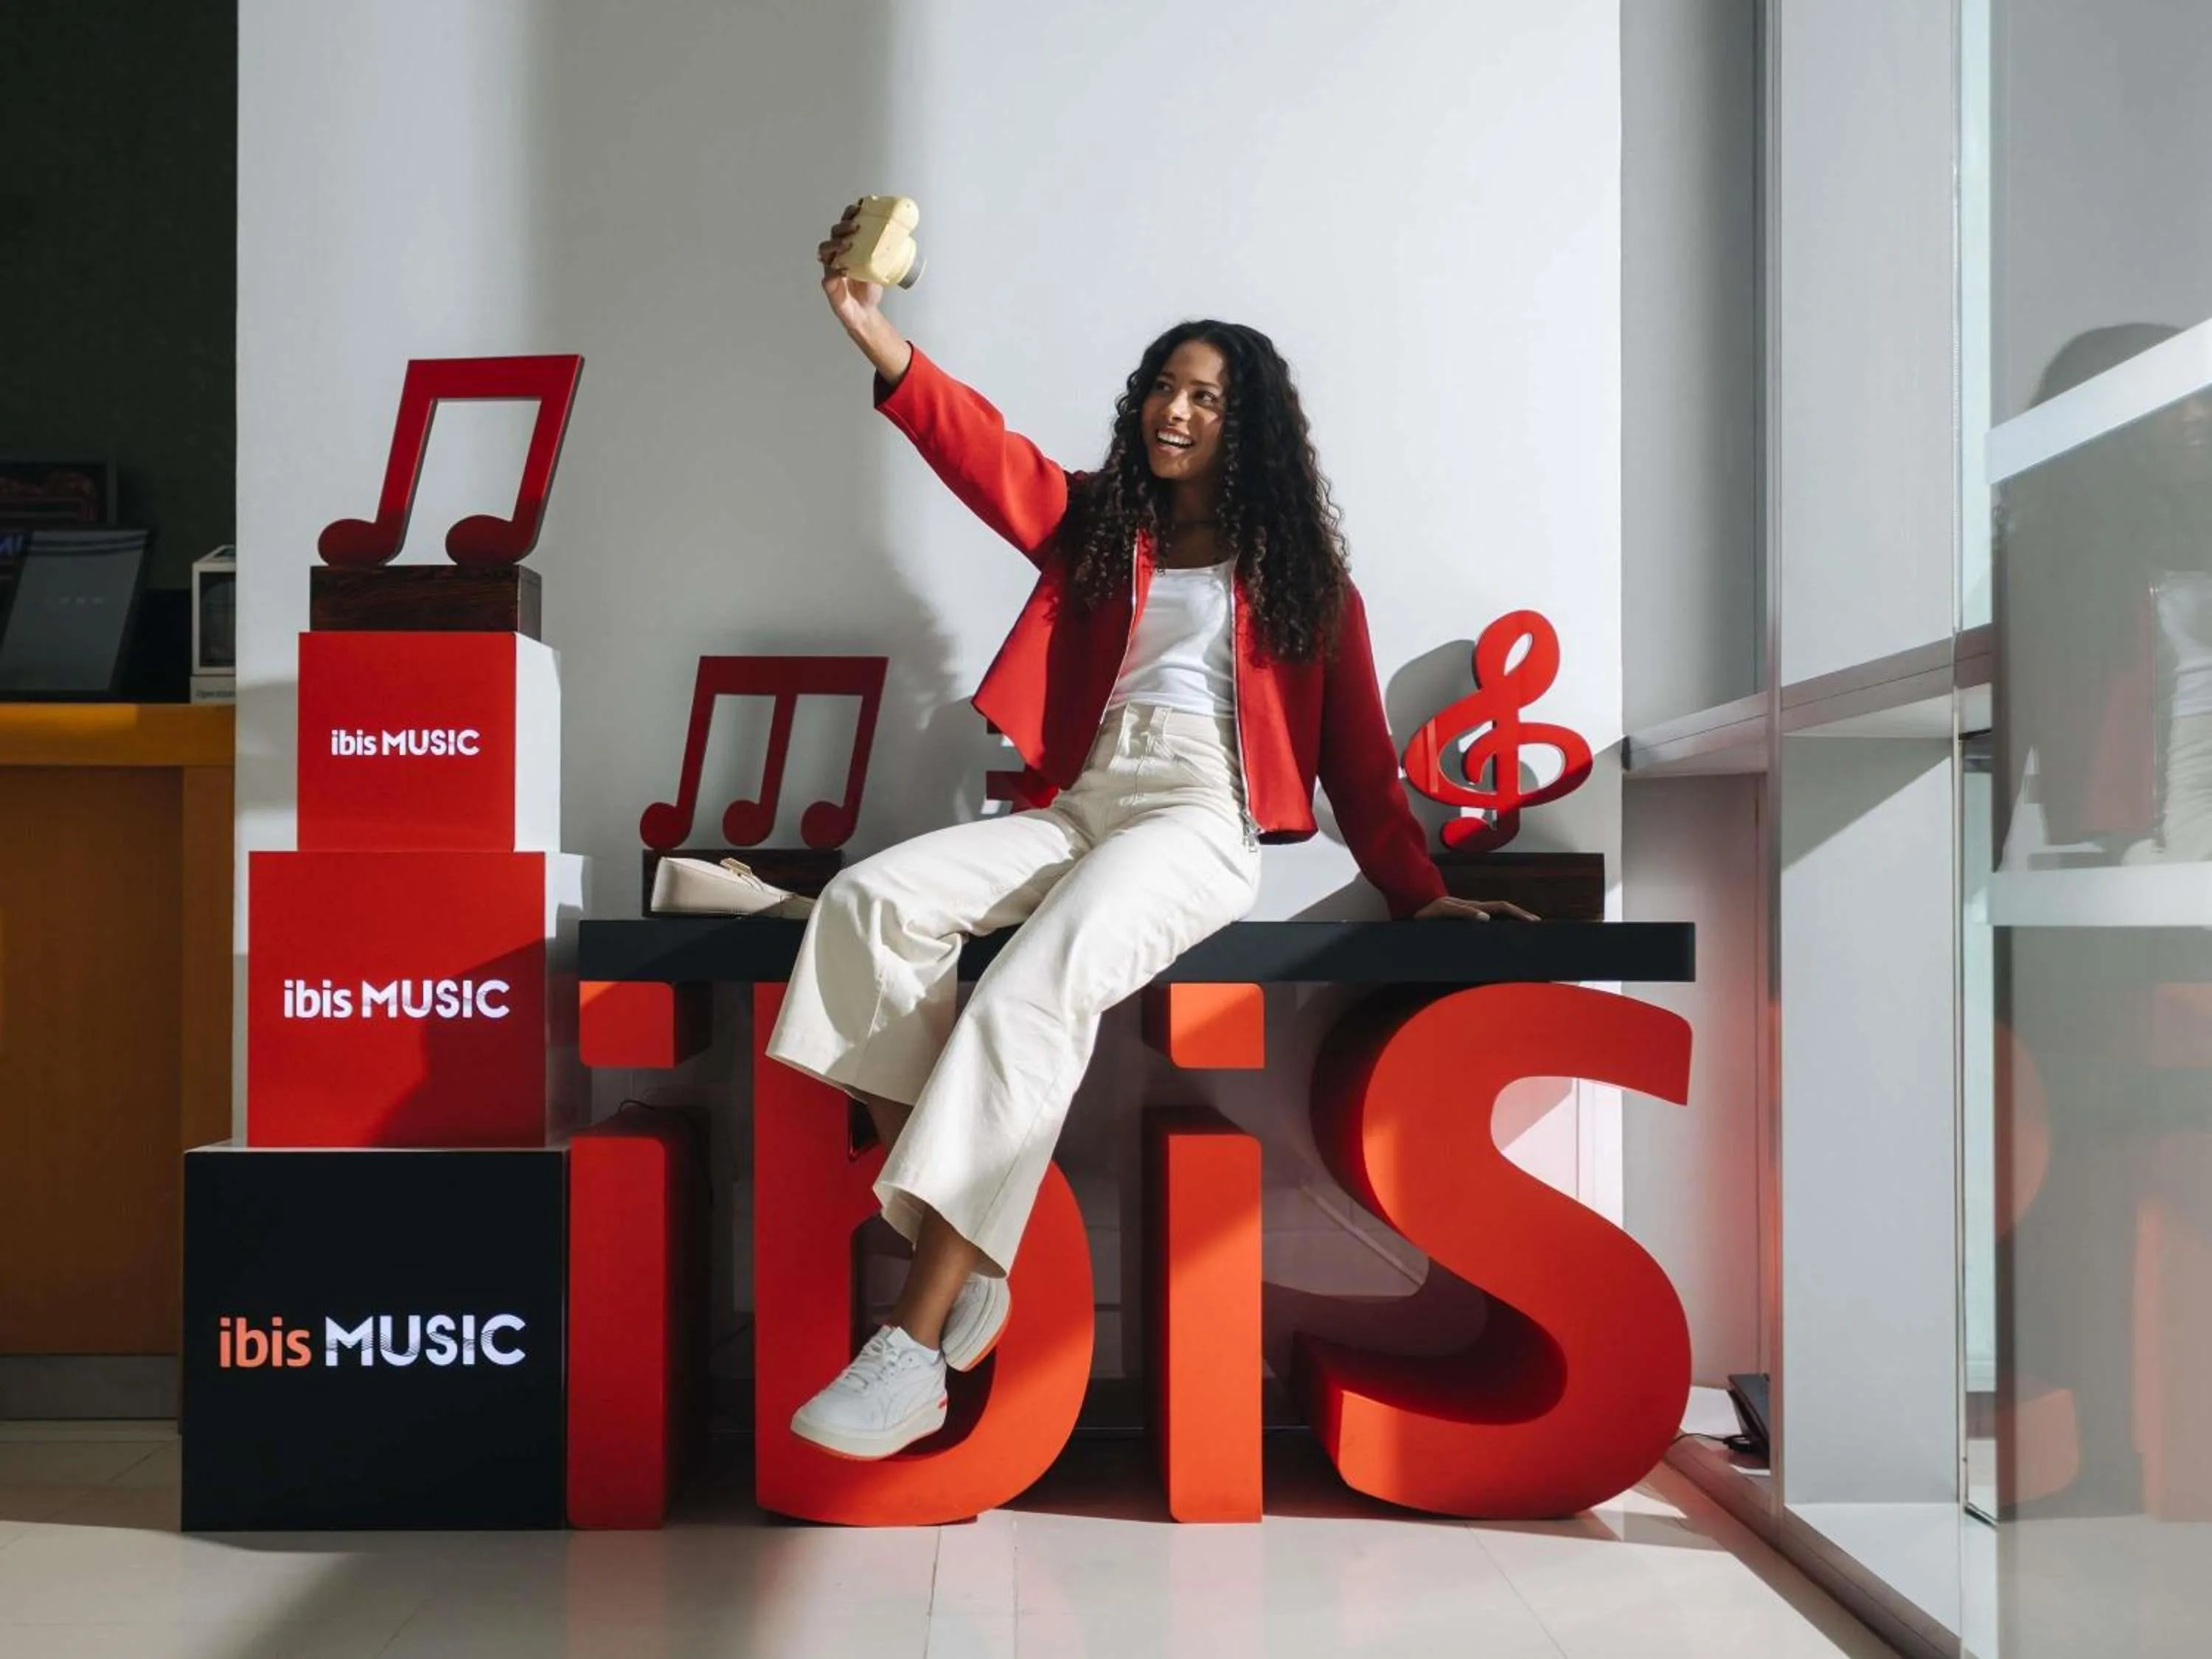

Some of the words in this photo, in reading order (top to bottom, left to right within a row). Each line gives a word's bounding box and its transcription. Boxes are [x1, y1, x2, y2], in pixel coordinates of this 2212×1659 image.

[331, 729, 377, 756] ibis
[381, 729, 480, 756] MUSIC
[284, 979, 353, 1018] ibis
[361, 979, 510, 1018] MUSIC
[220, 1317, 313, 1368] ibis
[325, 1314, 526, 1366] MUSIC
